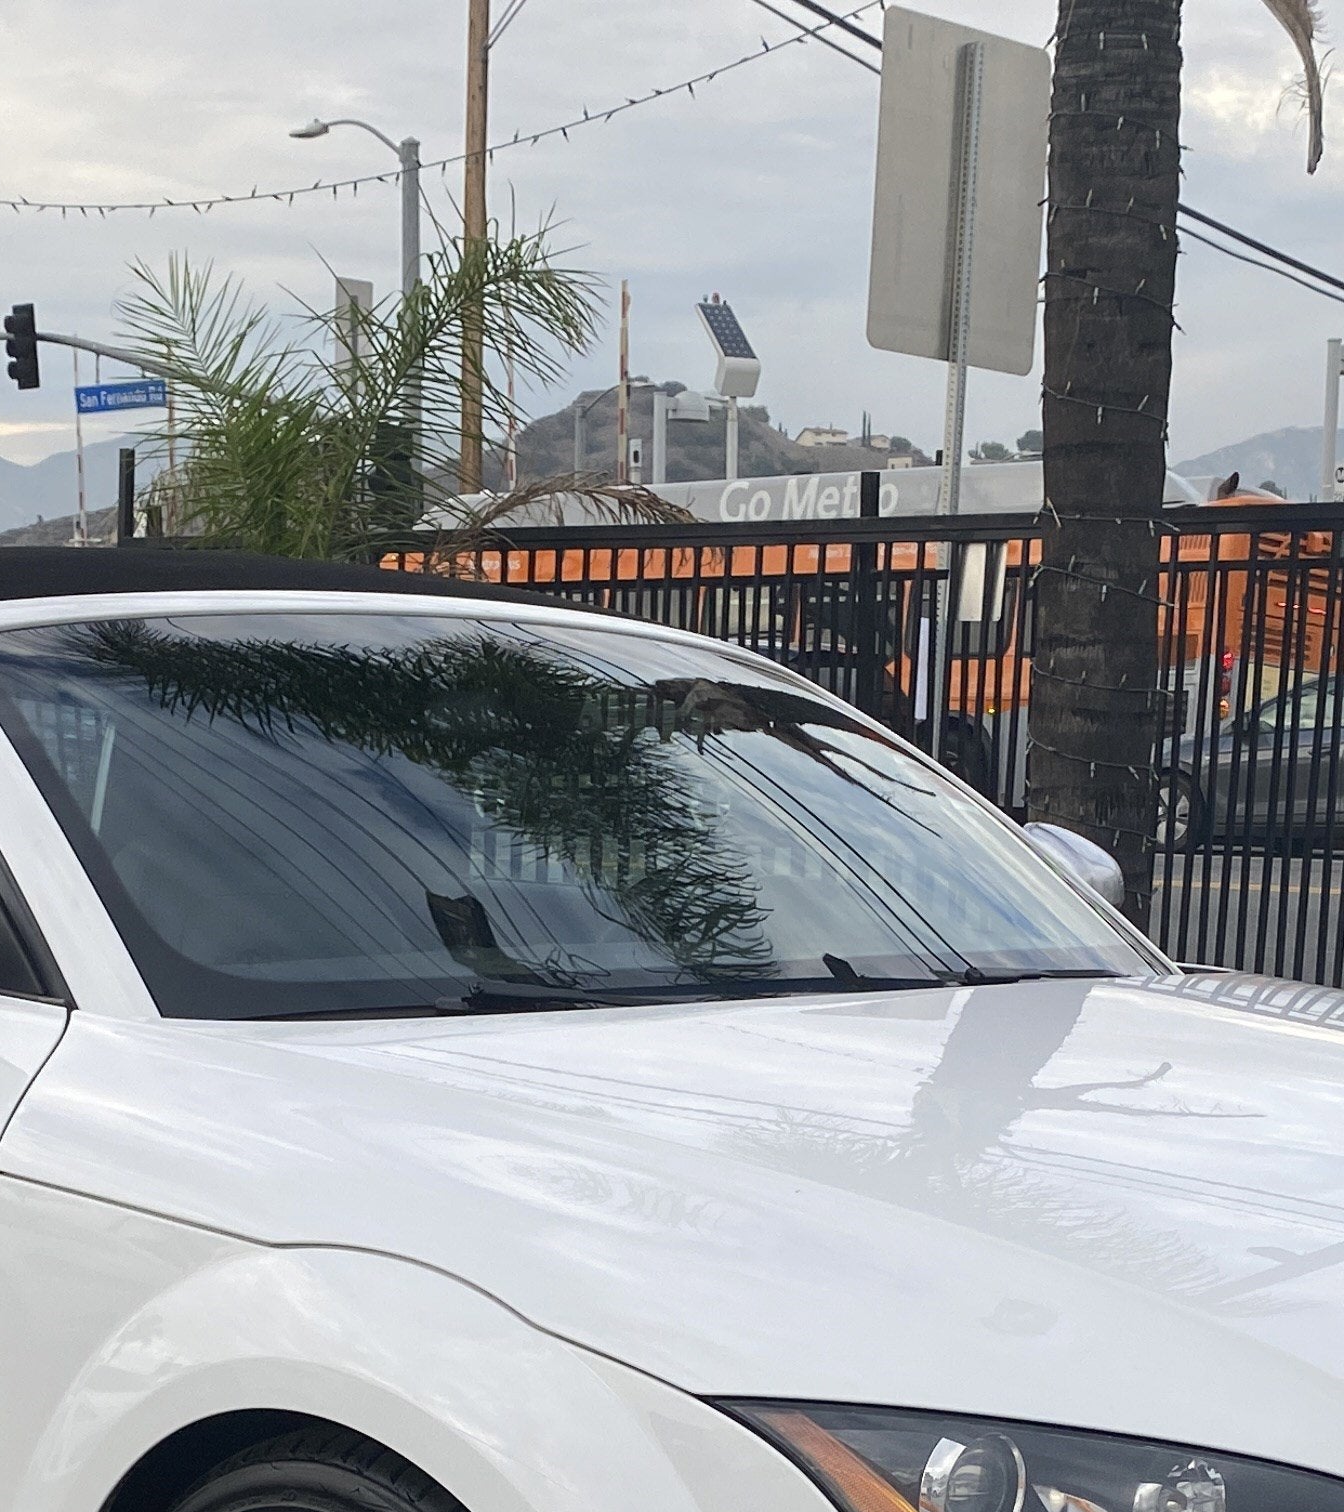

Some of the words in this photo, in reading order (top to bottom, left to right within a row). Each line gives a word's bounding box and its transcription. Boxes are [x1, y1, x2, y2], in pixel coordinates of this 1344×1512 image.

[80, 392, 98, 408] San
[720, 481, 771, 522] Go
[782, 476, 899, 520] Meto
